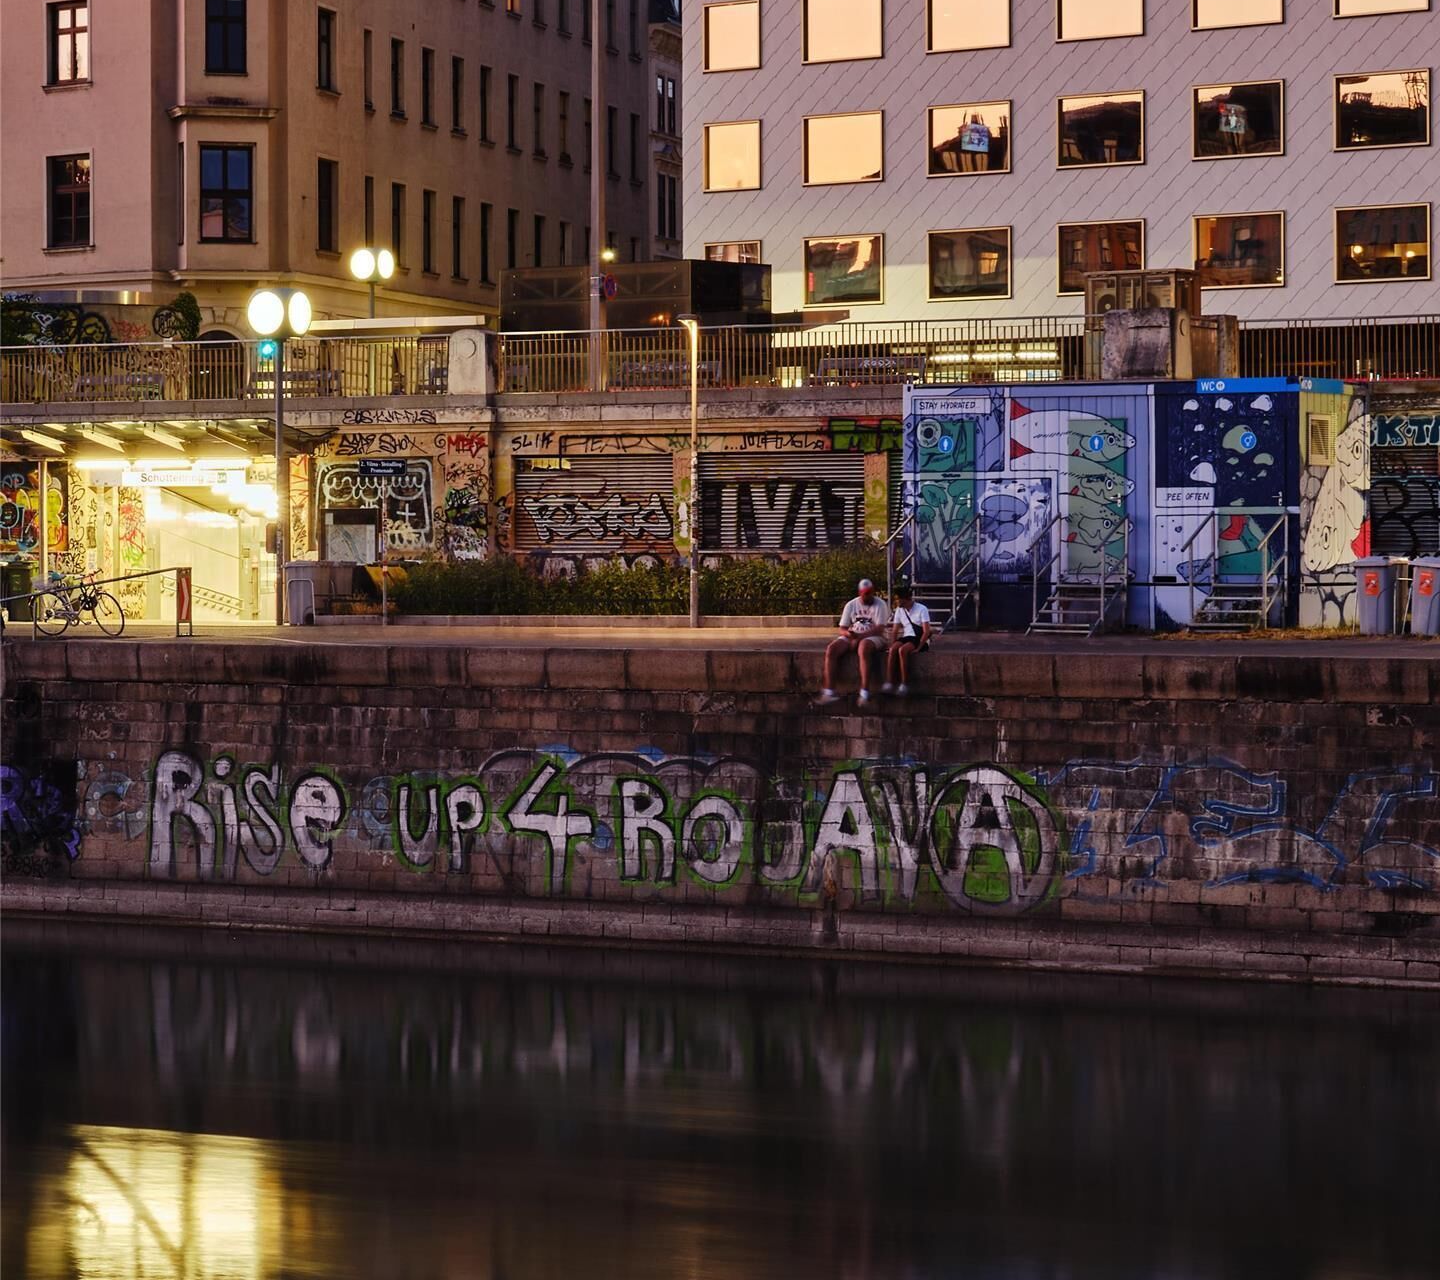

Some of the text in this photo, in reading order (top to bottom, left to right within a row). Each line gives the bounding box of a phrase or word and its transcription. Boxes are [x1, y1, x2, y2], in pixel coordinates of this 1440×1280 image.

[1201, 381, 1215, 391] WC
[919, 401, 937, 410] STAY
[1167, 492, 1210, 501] PEE OFTEN
[507, 759, 594, 895] 4
